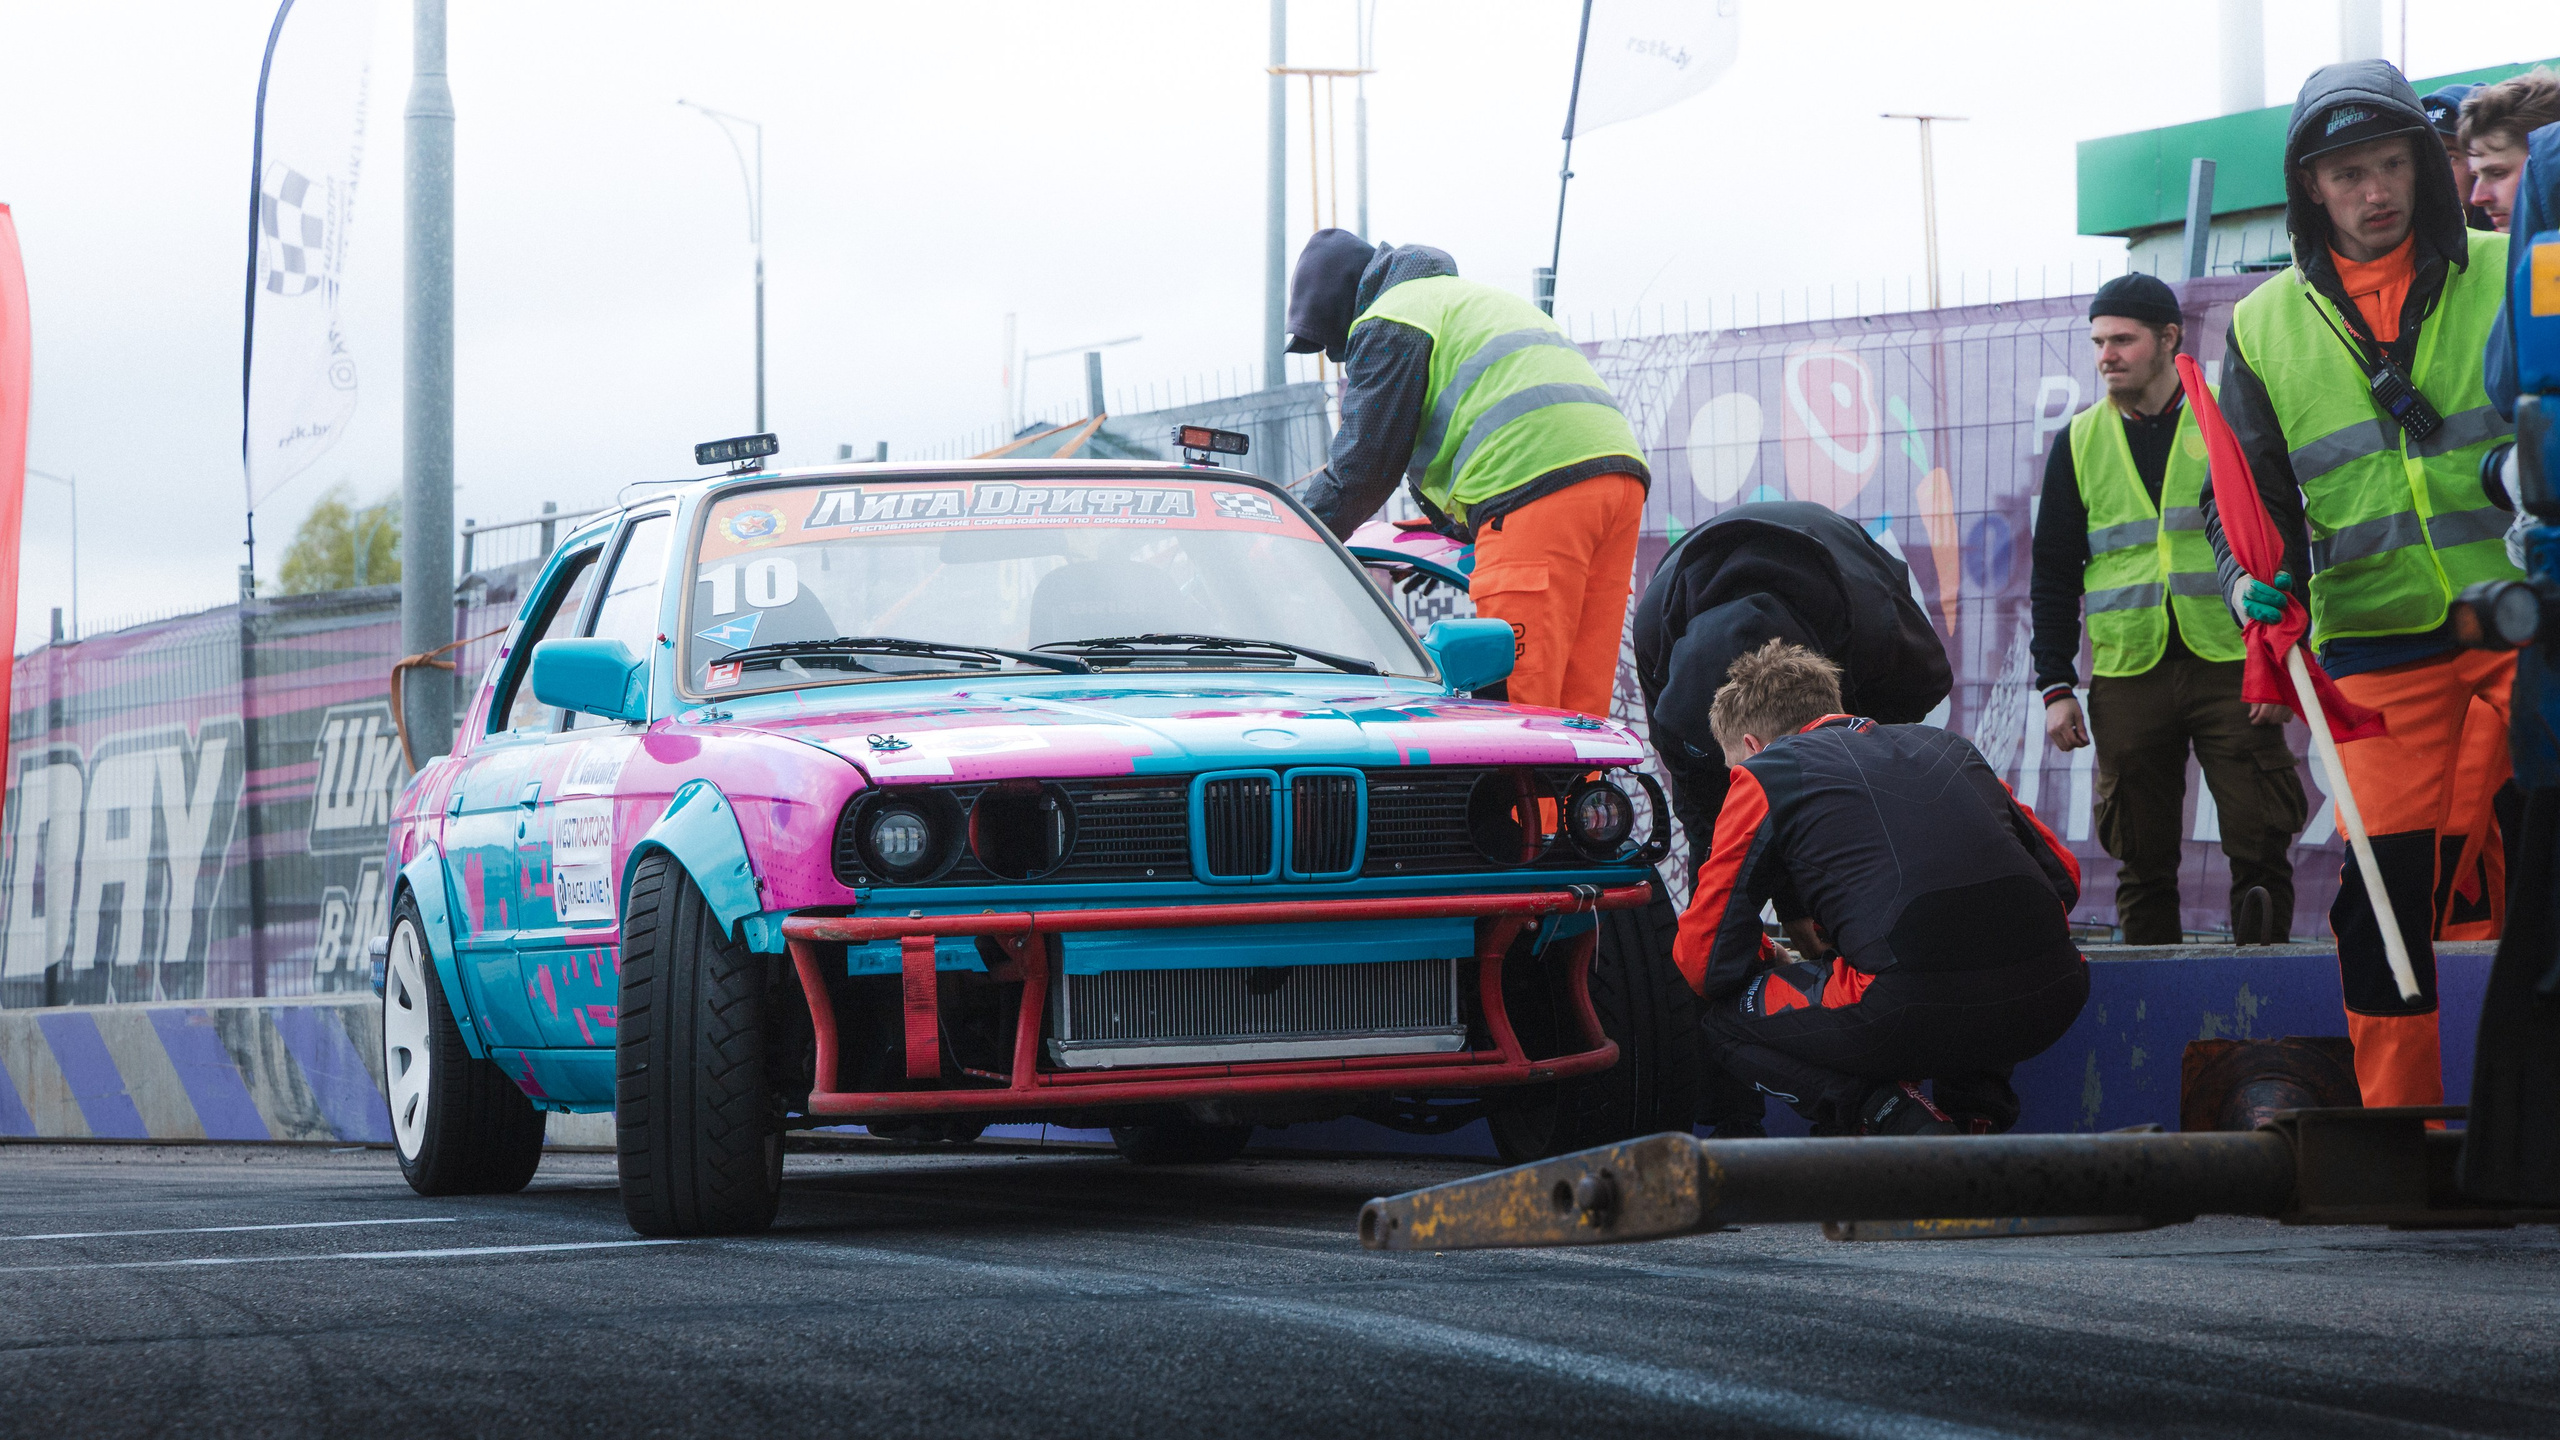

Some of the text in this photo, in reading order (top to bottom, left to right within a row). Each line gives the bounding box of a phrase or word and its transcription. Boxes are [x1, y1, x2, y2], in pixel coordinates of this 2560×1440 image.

[850, 517, 1167, 533] РЕСПУБЛИКАНСКИЕ СОРЕВНОВАНИЯ ПО ДРИФТИНГУ
[698, 557, 798, 616] 10
[3, 737, 229, 979] DAY
